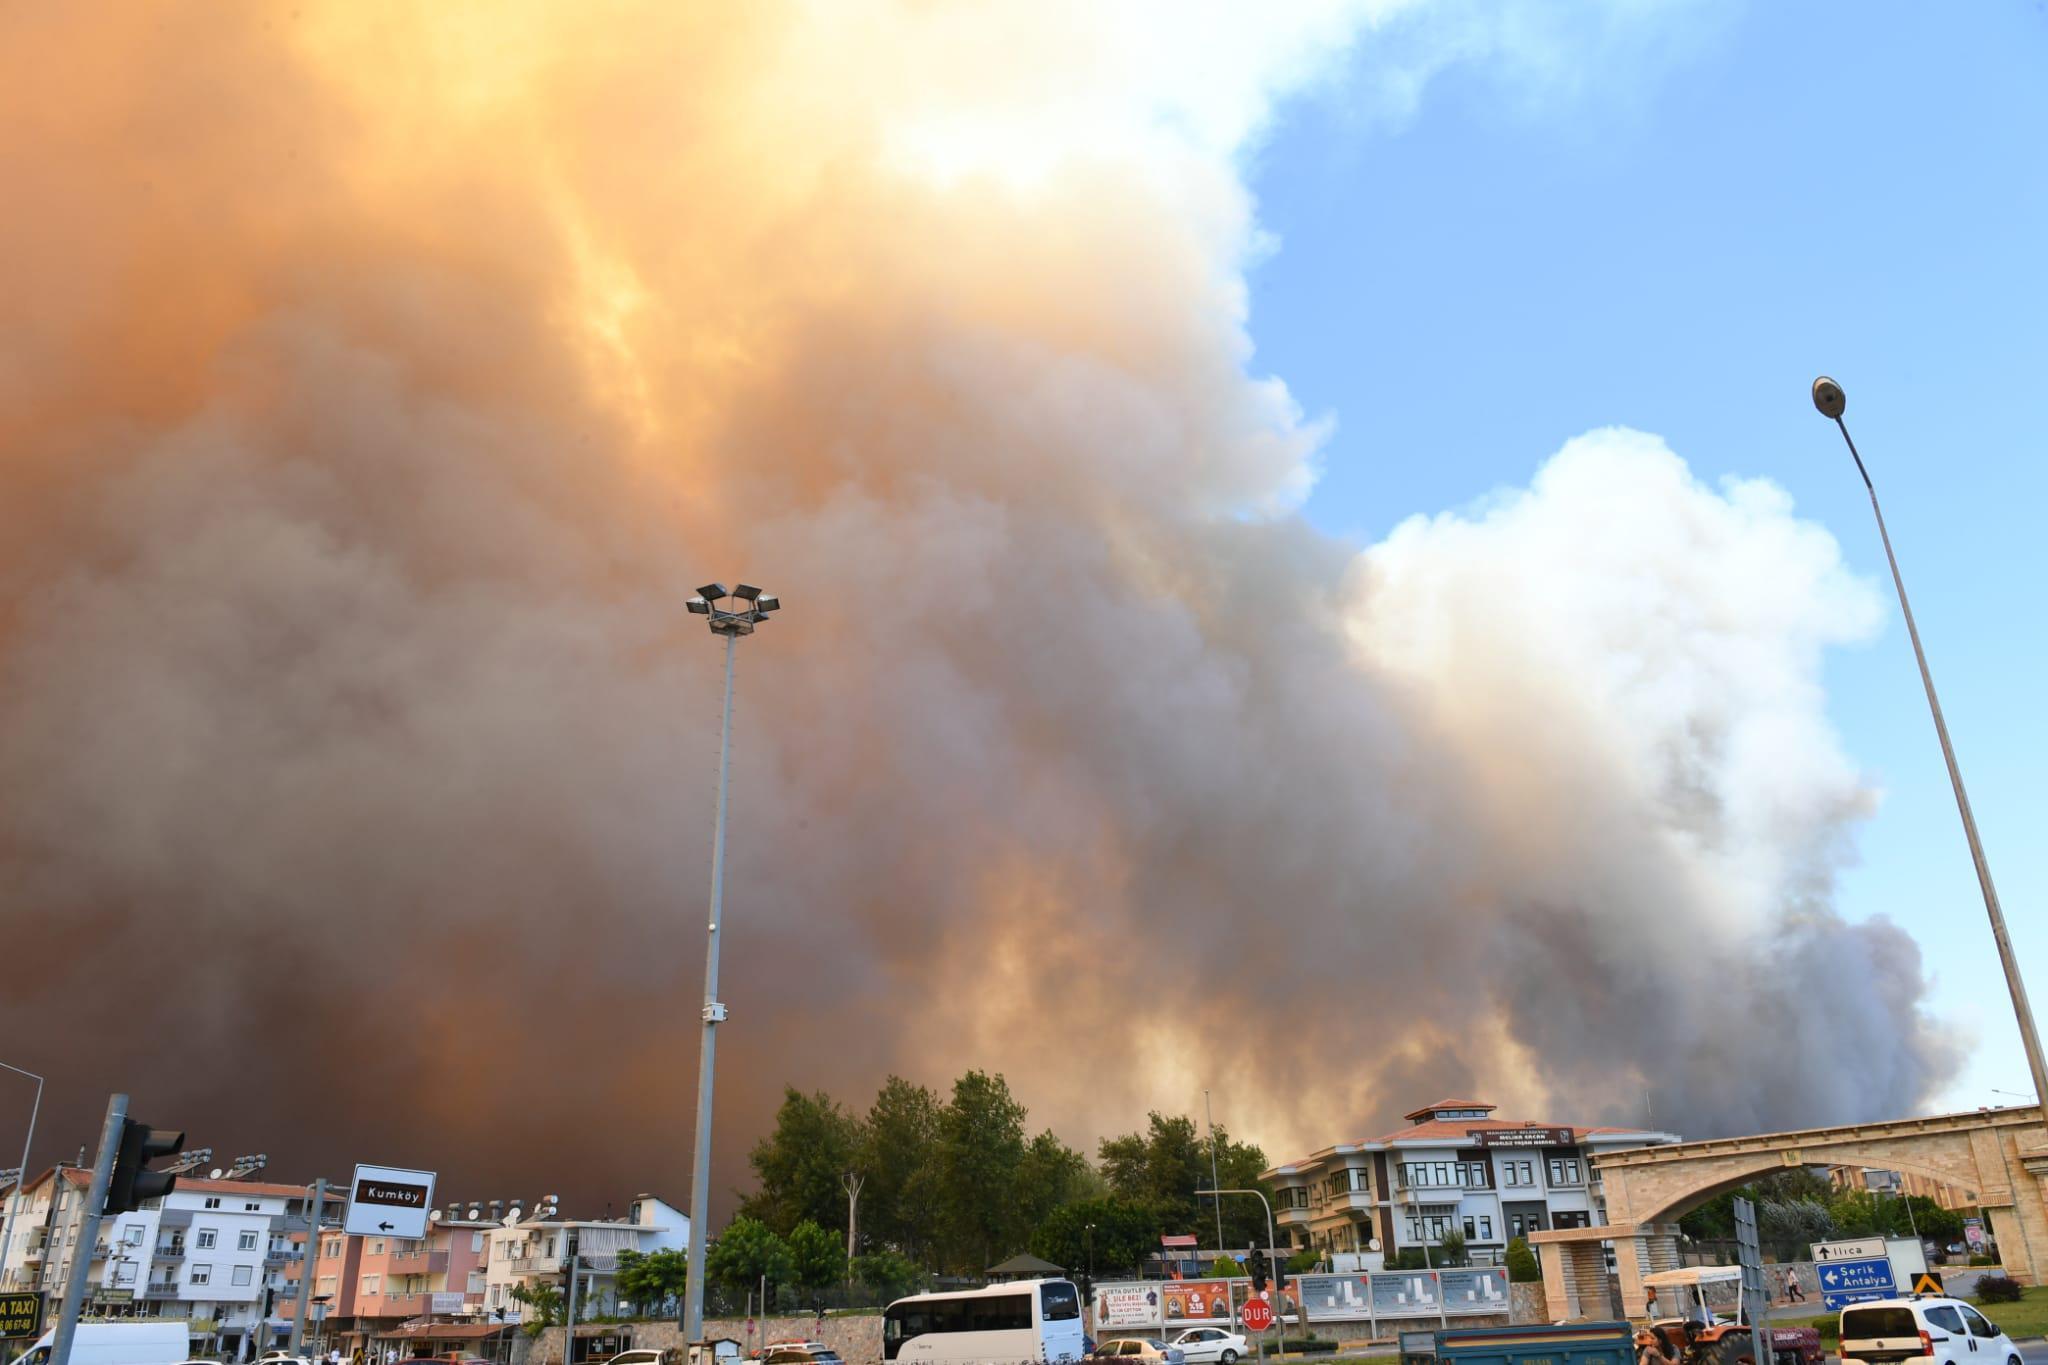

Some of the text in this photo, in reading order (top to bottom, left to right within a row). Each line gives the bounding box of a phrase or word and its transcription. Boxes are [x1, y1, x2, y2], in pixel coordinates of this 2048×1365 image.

[368, 1187, 419, 1204] Kumköy
[1840, 1265, 1875, 1276] Serik
[1844, 1276, 1887, 1287] Antalya
[11, 1300, 34, 1315] TAXI
[1244, 1308, 1270, 1321] DUR
